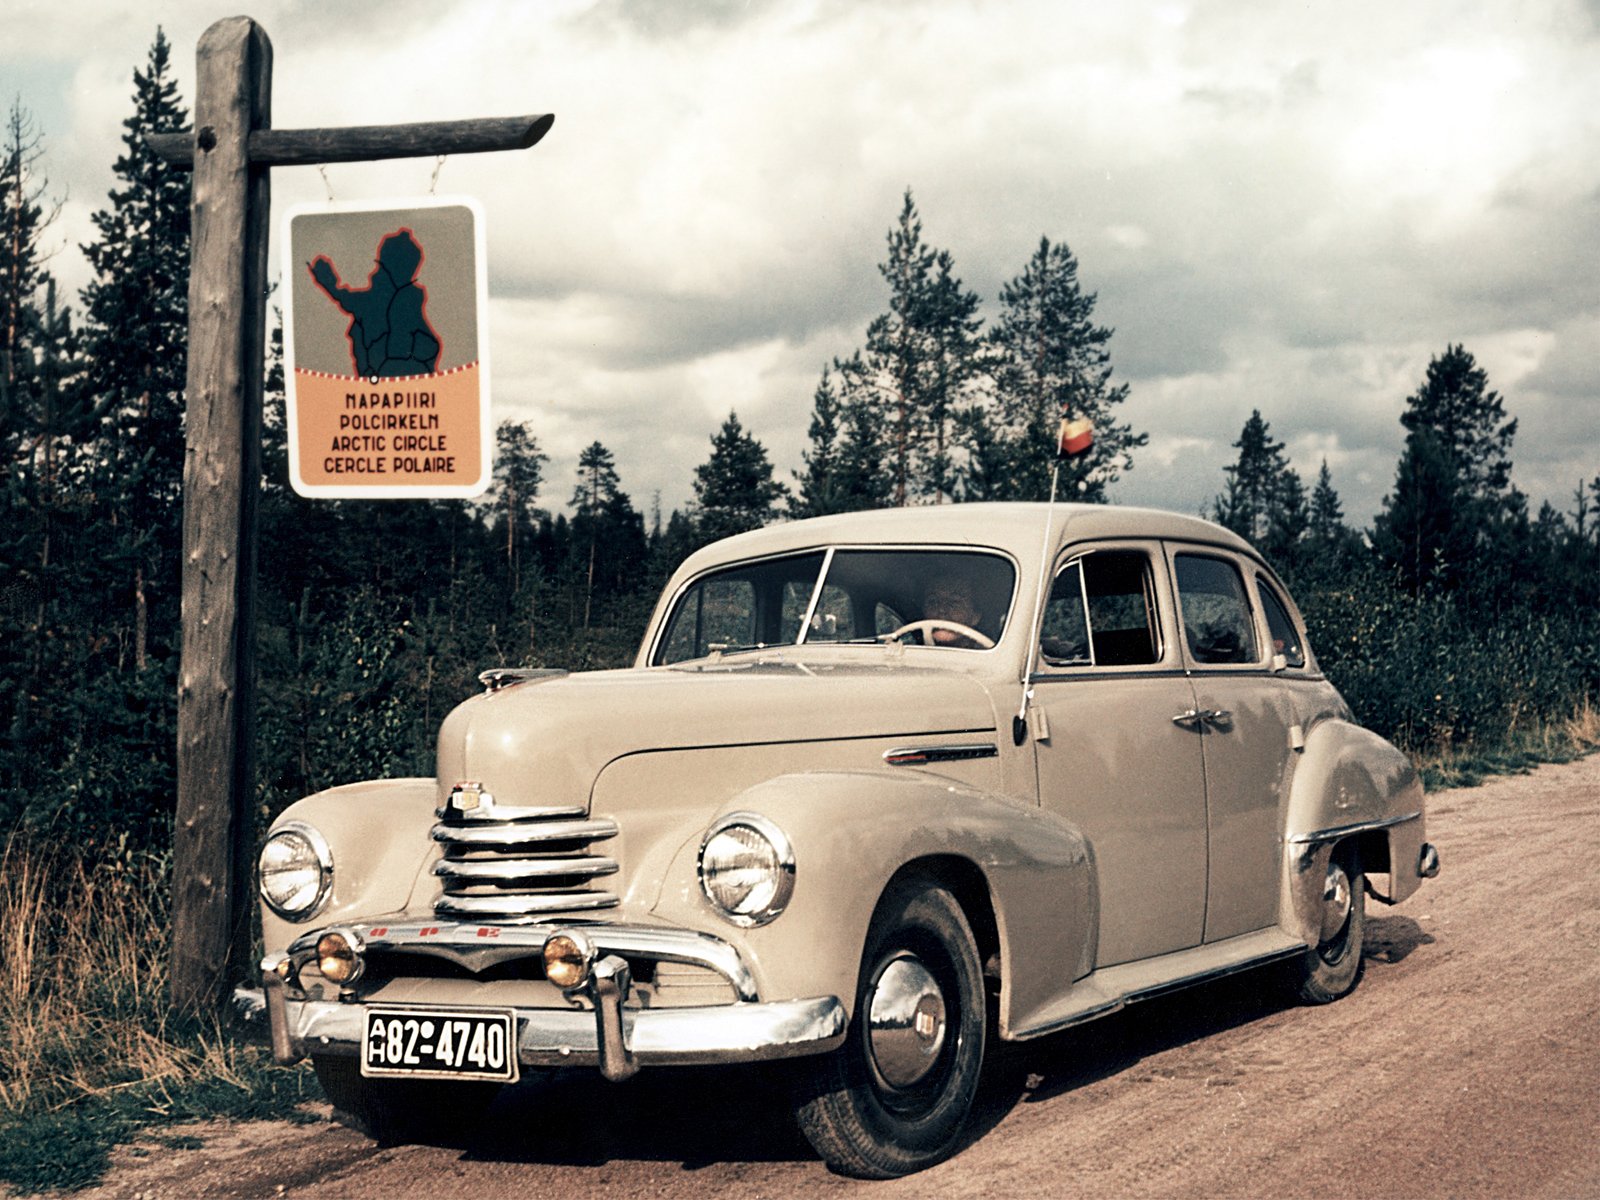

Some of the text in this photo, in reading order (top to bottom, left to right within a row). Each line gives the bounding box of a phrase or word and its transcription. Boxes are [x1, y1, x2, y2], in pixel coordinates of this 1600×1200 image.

[345, 392, 436, 409] NAPAPIIRI
[340, 414, 439, 430] POLCIRKELN
[331, 435, 447, 451] ARCTIC CIRCLE
[324, 456, 456, 473] CERCLE POLAIRE
